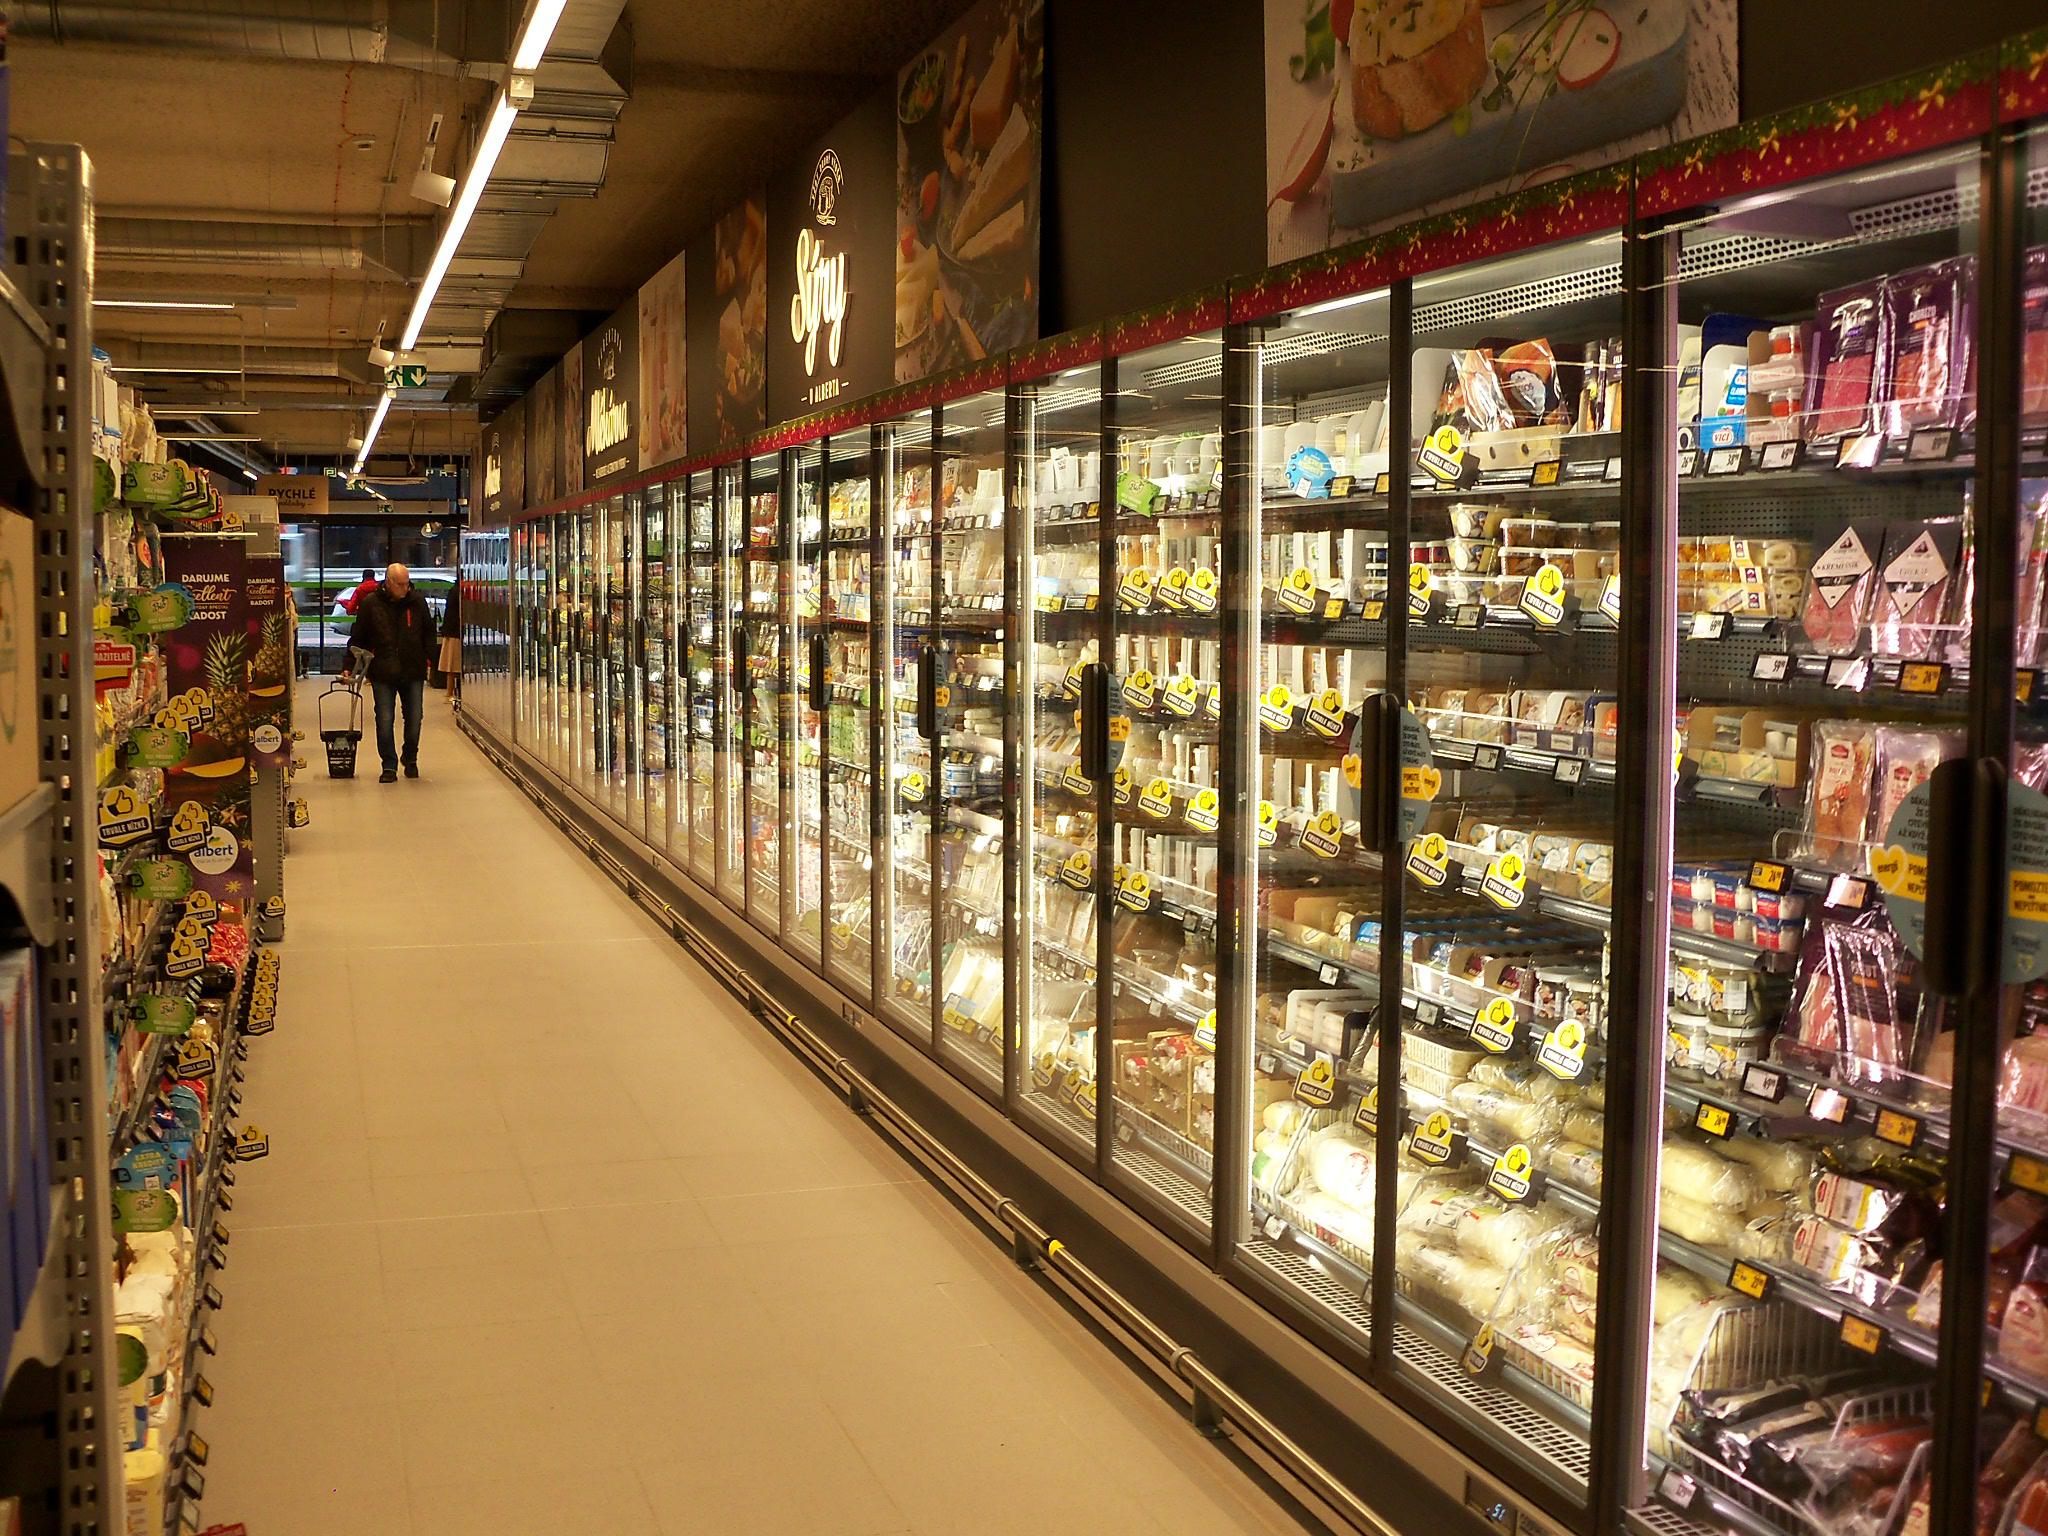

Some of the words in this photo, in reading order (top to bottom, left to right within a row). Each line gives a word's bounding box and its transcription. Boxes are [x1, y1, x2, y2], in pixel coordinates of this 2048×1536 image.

[791, 229, 847, 376] Sýry
[815, 377, 840, 403] ALBERTA
[1714, 433, 1730, 442] VICI
[181, 574, 230, 583] DARUJME
[192, 585, 237, 602] cellent
[256, 735, 279, 743] albert
